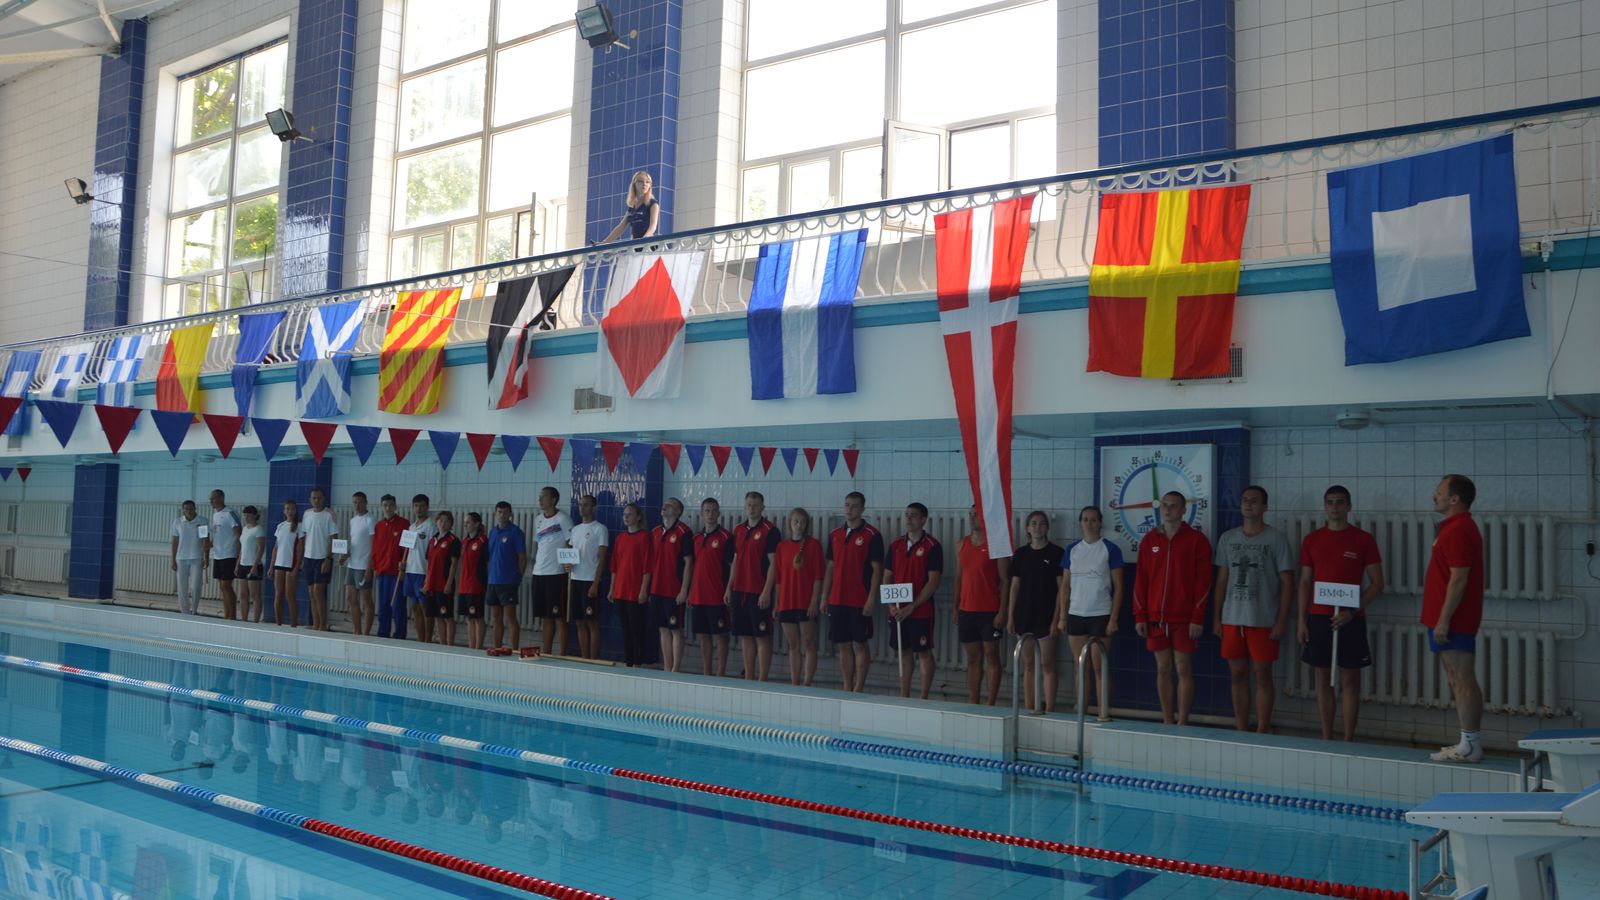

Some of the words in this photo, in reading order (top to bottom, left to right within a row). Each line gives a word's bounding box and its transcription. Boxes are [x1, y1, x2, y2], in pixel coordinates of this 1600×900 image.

[1154, 450, 1161, 459] 60
[1132, 457, 1138, 465] 55
[1178, 456, 1183, 465] 5
[1200, 500, 1208, 509] 15
[883, 587, 909, 600] ЗВО
